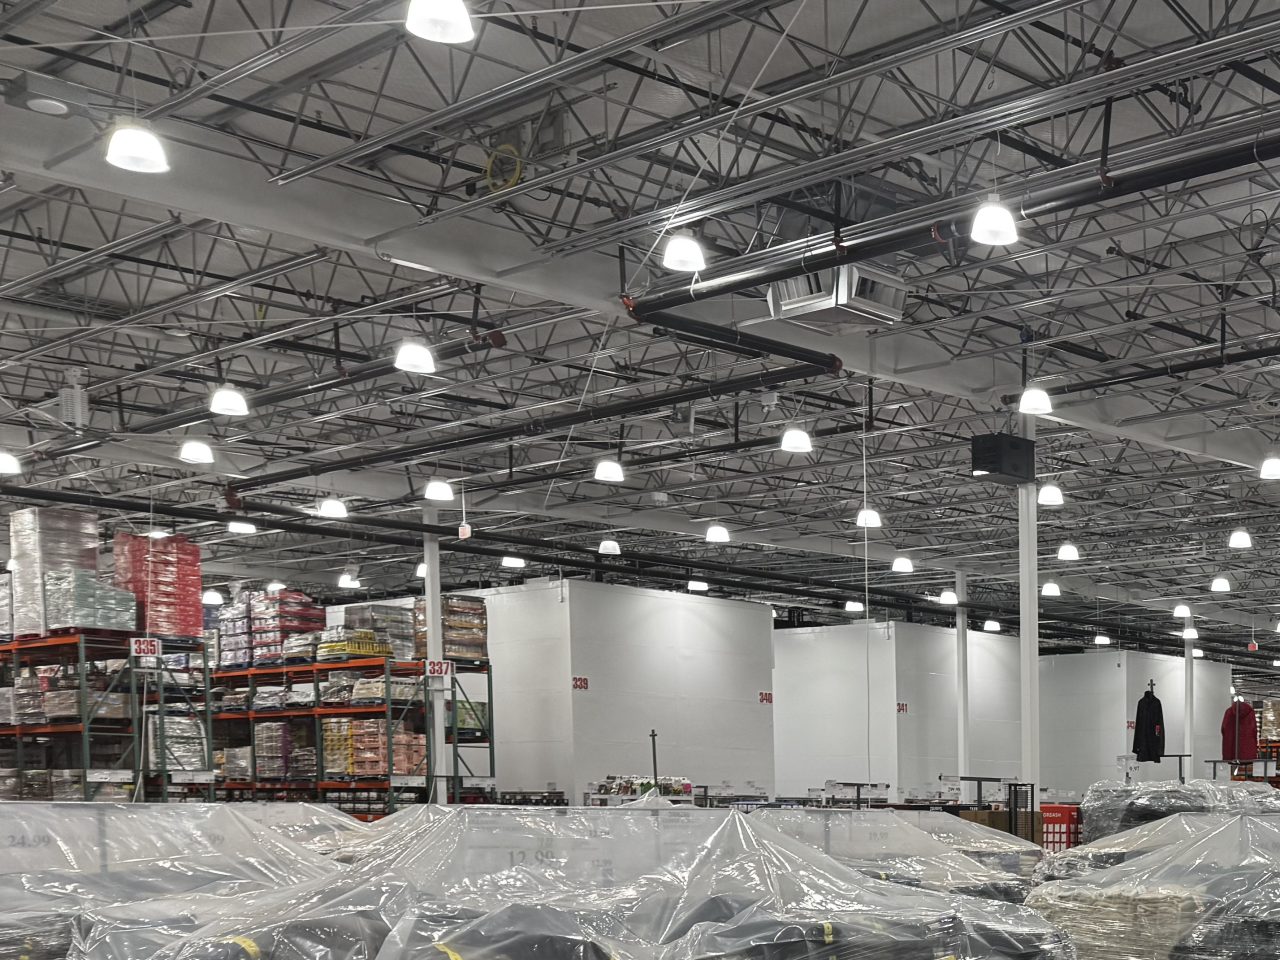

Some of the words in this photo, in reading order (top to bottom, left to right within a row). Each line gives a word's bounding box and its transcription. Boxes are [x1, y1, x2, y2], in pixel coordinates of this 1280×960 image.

[134, 640, 157, 655] 335
[428, 661, 450, 675] 337
[572, 677, 589, 690] 339
[896, 702, 908, 713] 341
